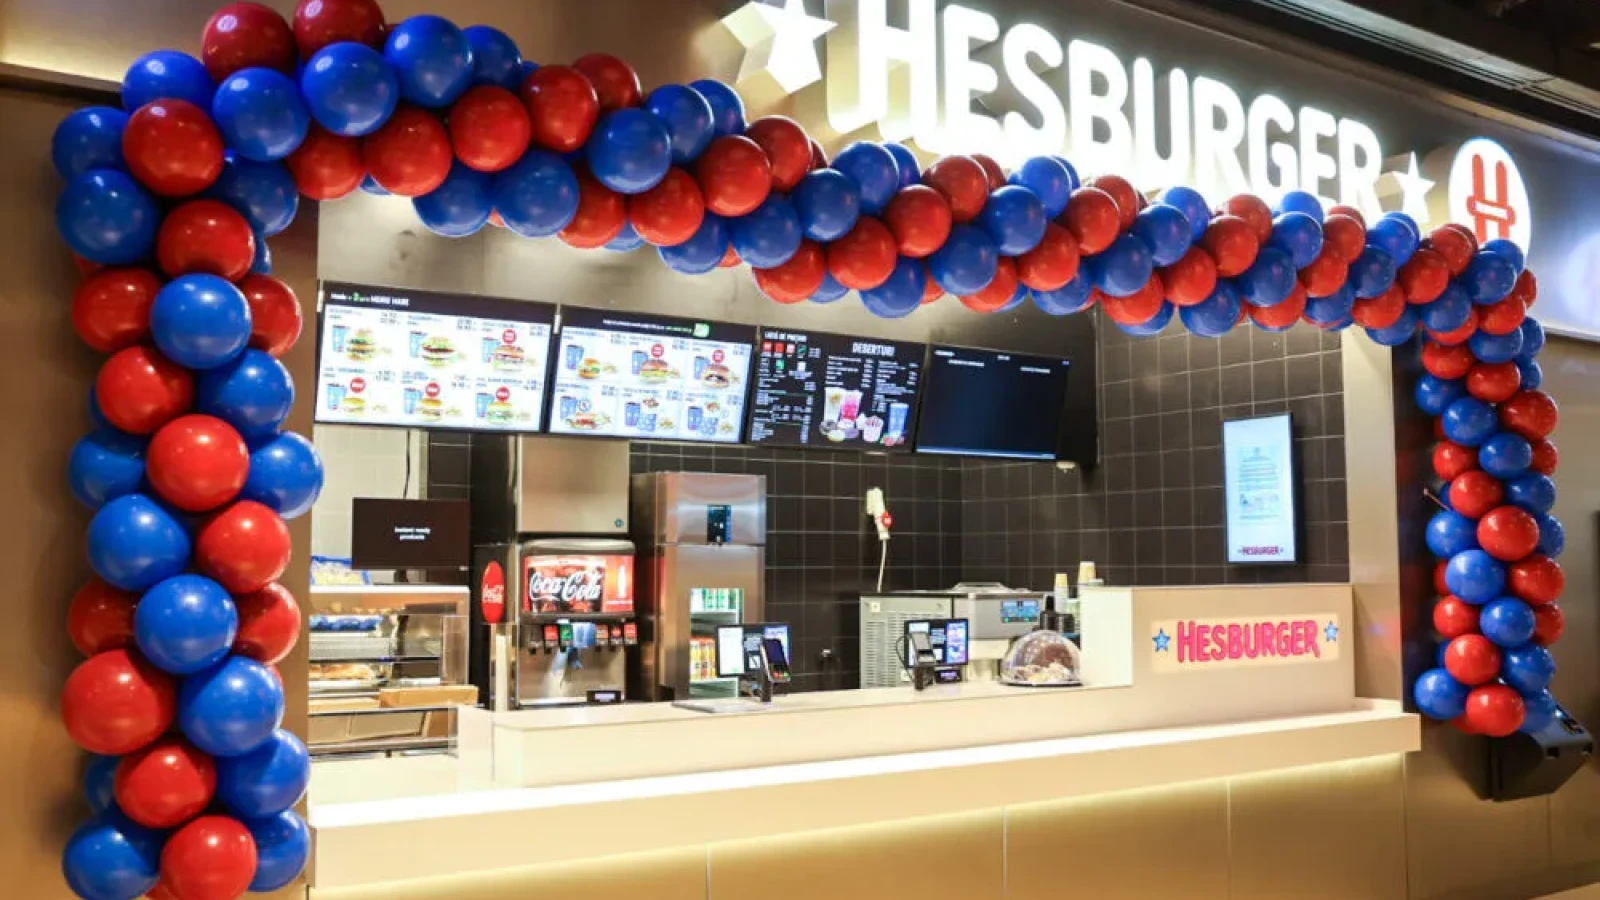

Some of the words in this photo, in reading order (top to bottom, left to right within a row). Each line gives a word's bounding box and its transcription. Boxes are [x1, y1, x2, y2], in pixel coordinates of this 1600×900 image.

[850, 0, 1383, 222] HESBURGER
[529, 568, 605, 601] Coca-Cola
[1176, 619, 1321, 663] HESBURGER
